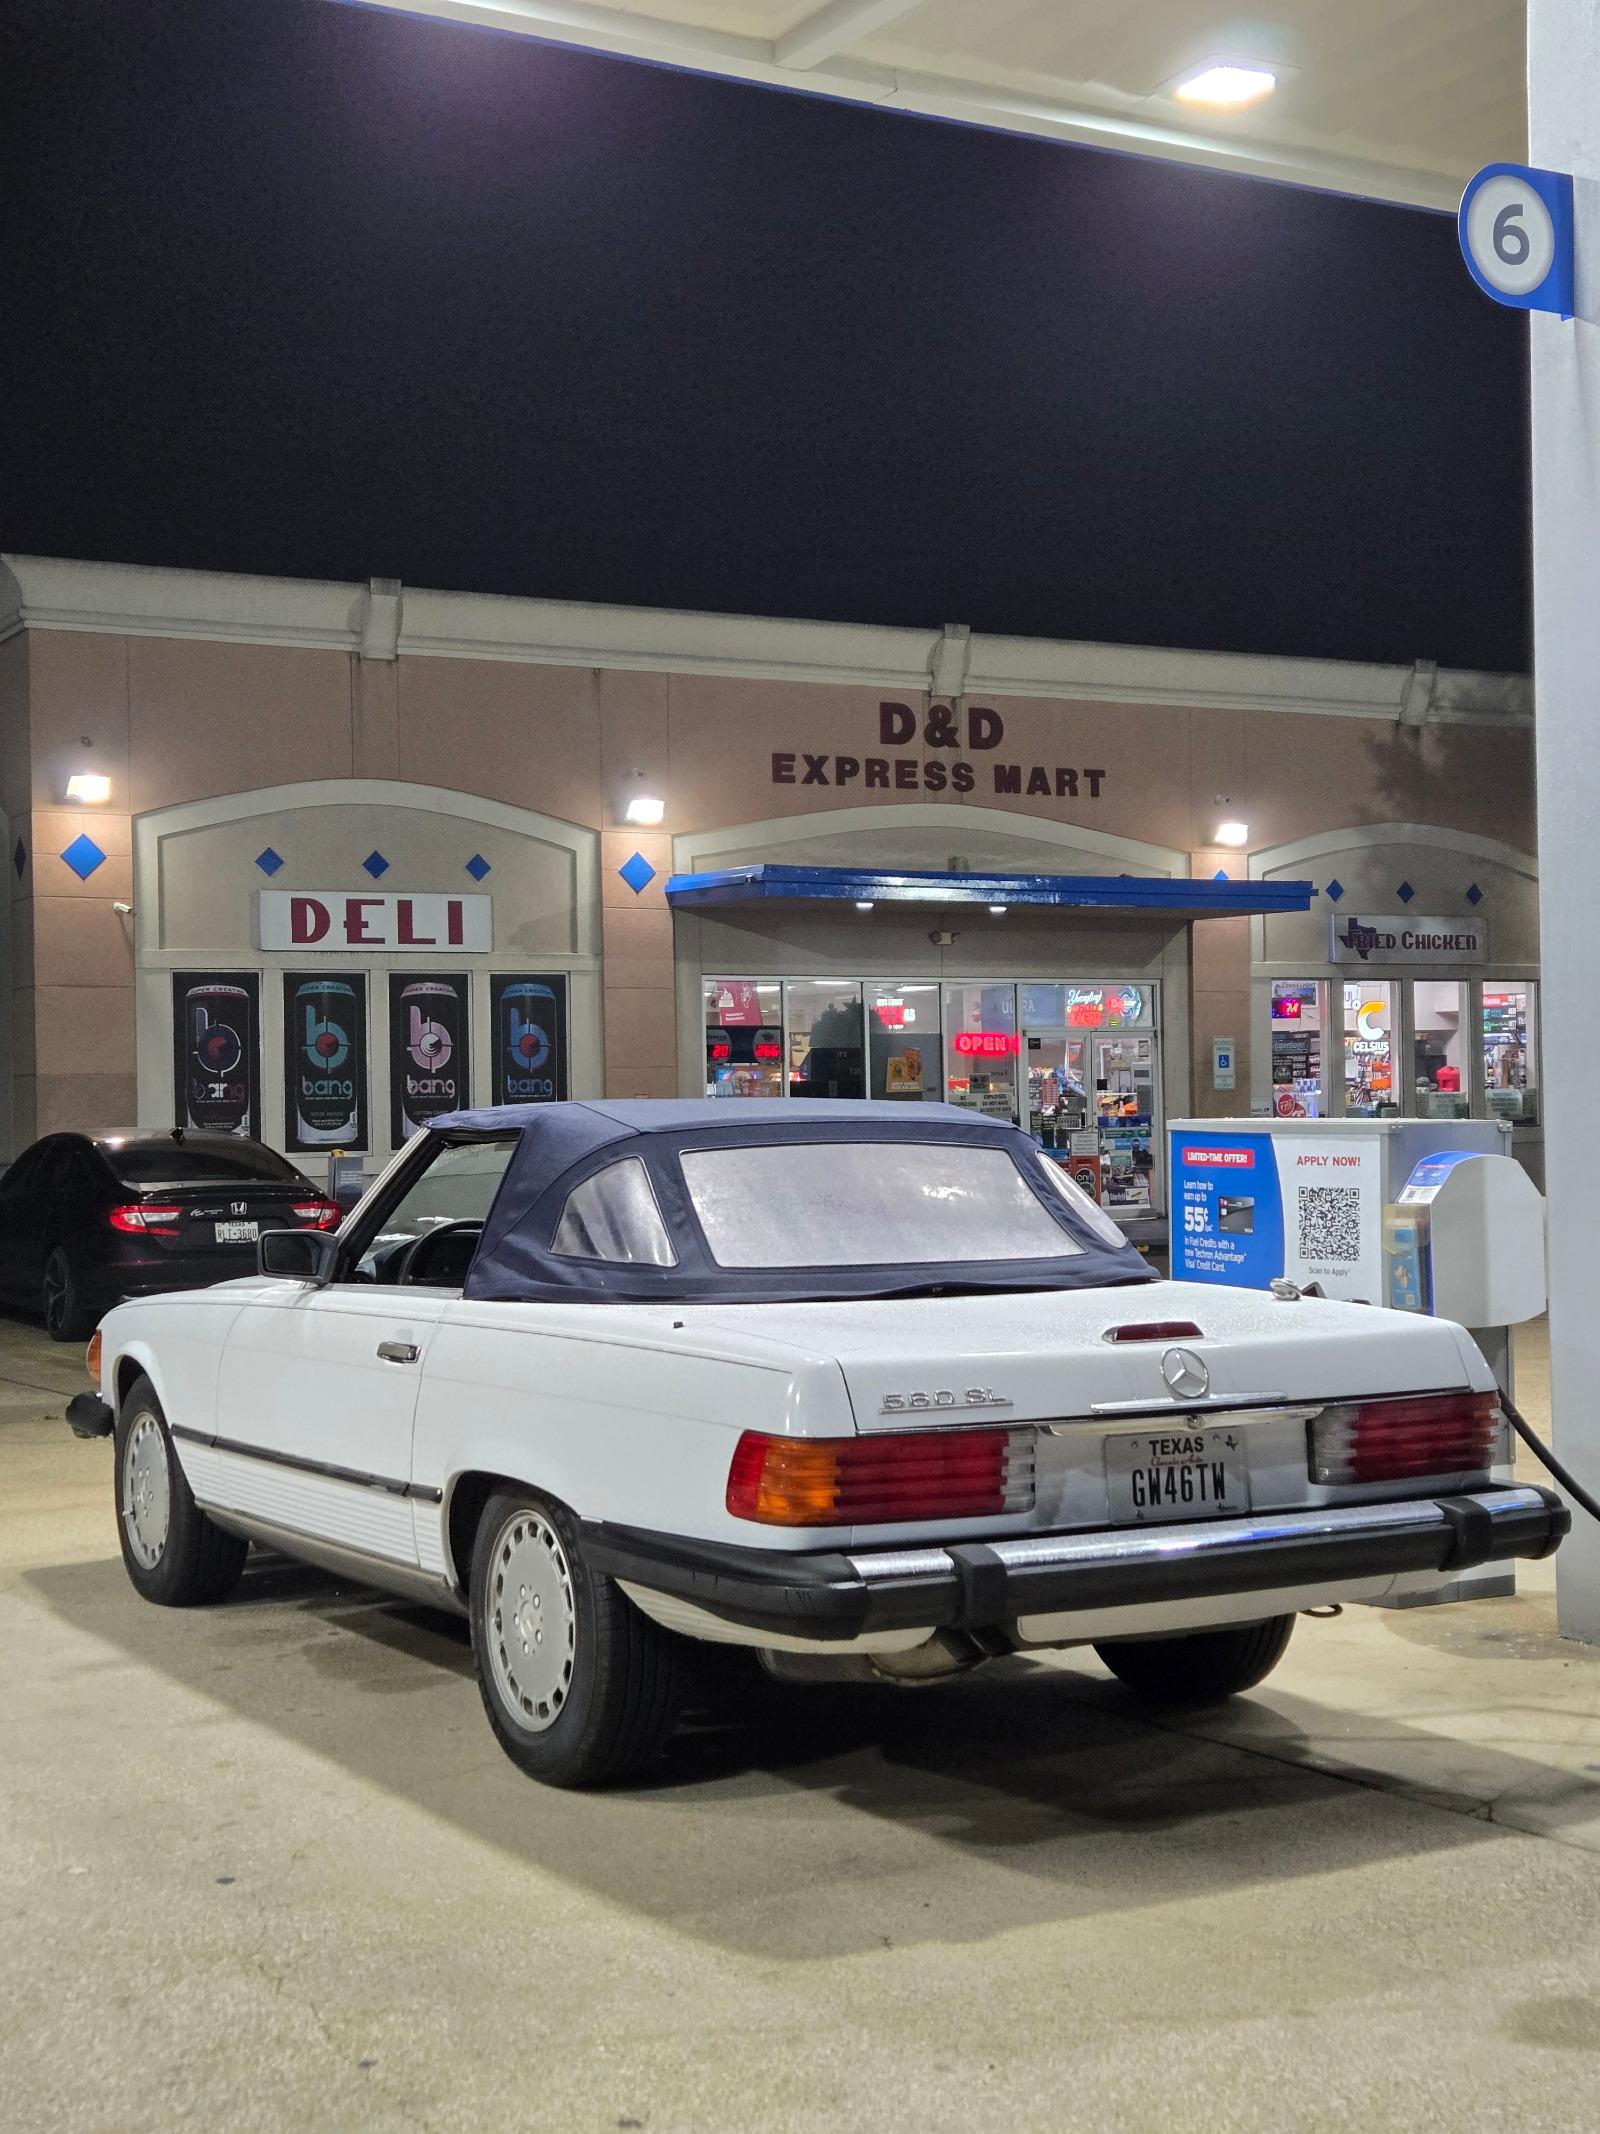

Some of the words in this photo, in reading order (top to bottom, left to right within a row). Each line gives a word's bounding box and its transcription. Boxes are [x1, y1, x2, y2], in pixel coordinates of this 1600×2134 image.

[1493, 203, 1530, 266] 6
[879, 701, 1004, 751] D&D
[771, 752, 976, 792] EXPRESS
[994, 764, 1106, 798] MART
[290, 897, 464, 945] DELI
[959, 1036, 1007, 1052] OPEN
[1353, 1041, 1390, 1052] CELSIUS
[302, 1075, 353, 1100] bang
[406, 1074, 456, 1099] bang
[507, 1074, 553, 1098] bang
[1187, 1151, 1223, 1163] LIMITED-TIME
[1224, 1152, 1248, 1164] OFFER!
[1296, 1156, 1329, 1166] APPLY
[1332, 1156, 1361, 1167] NOW!
[1183, 1180, 1197, 1190] Learn
[1197, 1181, 1207, 1190] how
[1189, 1236, 1200, 1246] Fuel
[1200, 1237, 1217, 1249] Credits
[1217, 1239, 1230, 1250] with
[1196, 1260, 1211, 1271] Credit
[1308, 1266, 1323, 1275] Scan
[1323, 1267, 1331, 1276] to
[883, 1389, 955, 1409] 560
[965, 1385, 1007, 1403] SL
[1148, 1436, 1205, 1456] TEXAS
[1131, 1461, 1226, 1508] GW46TW
